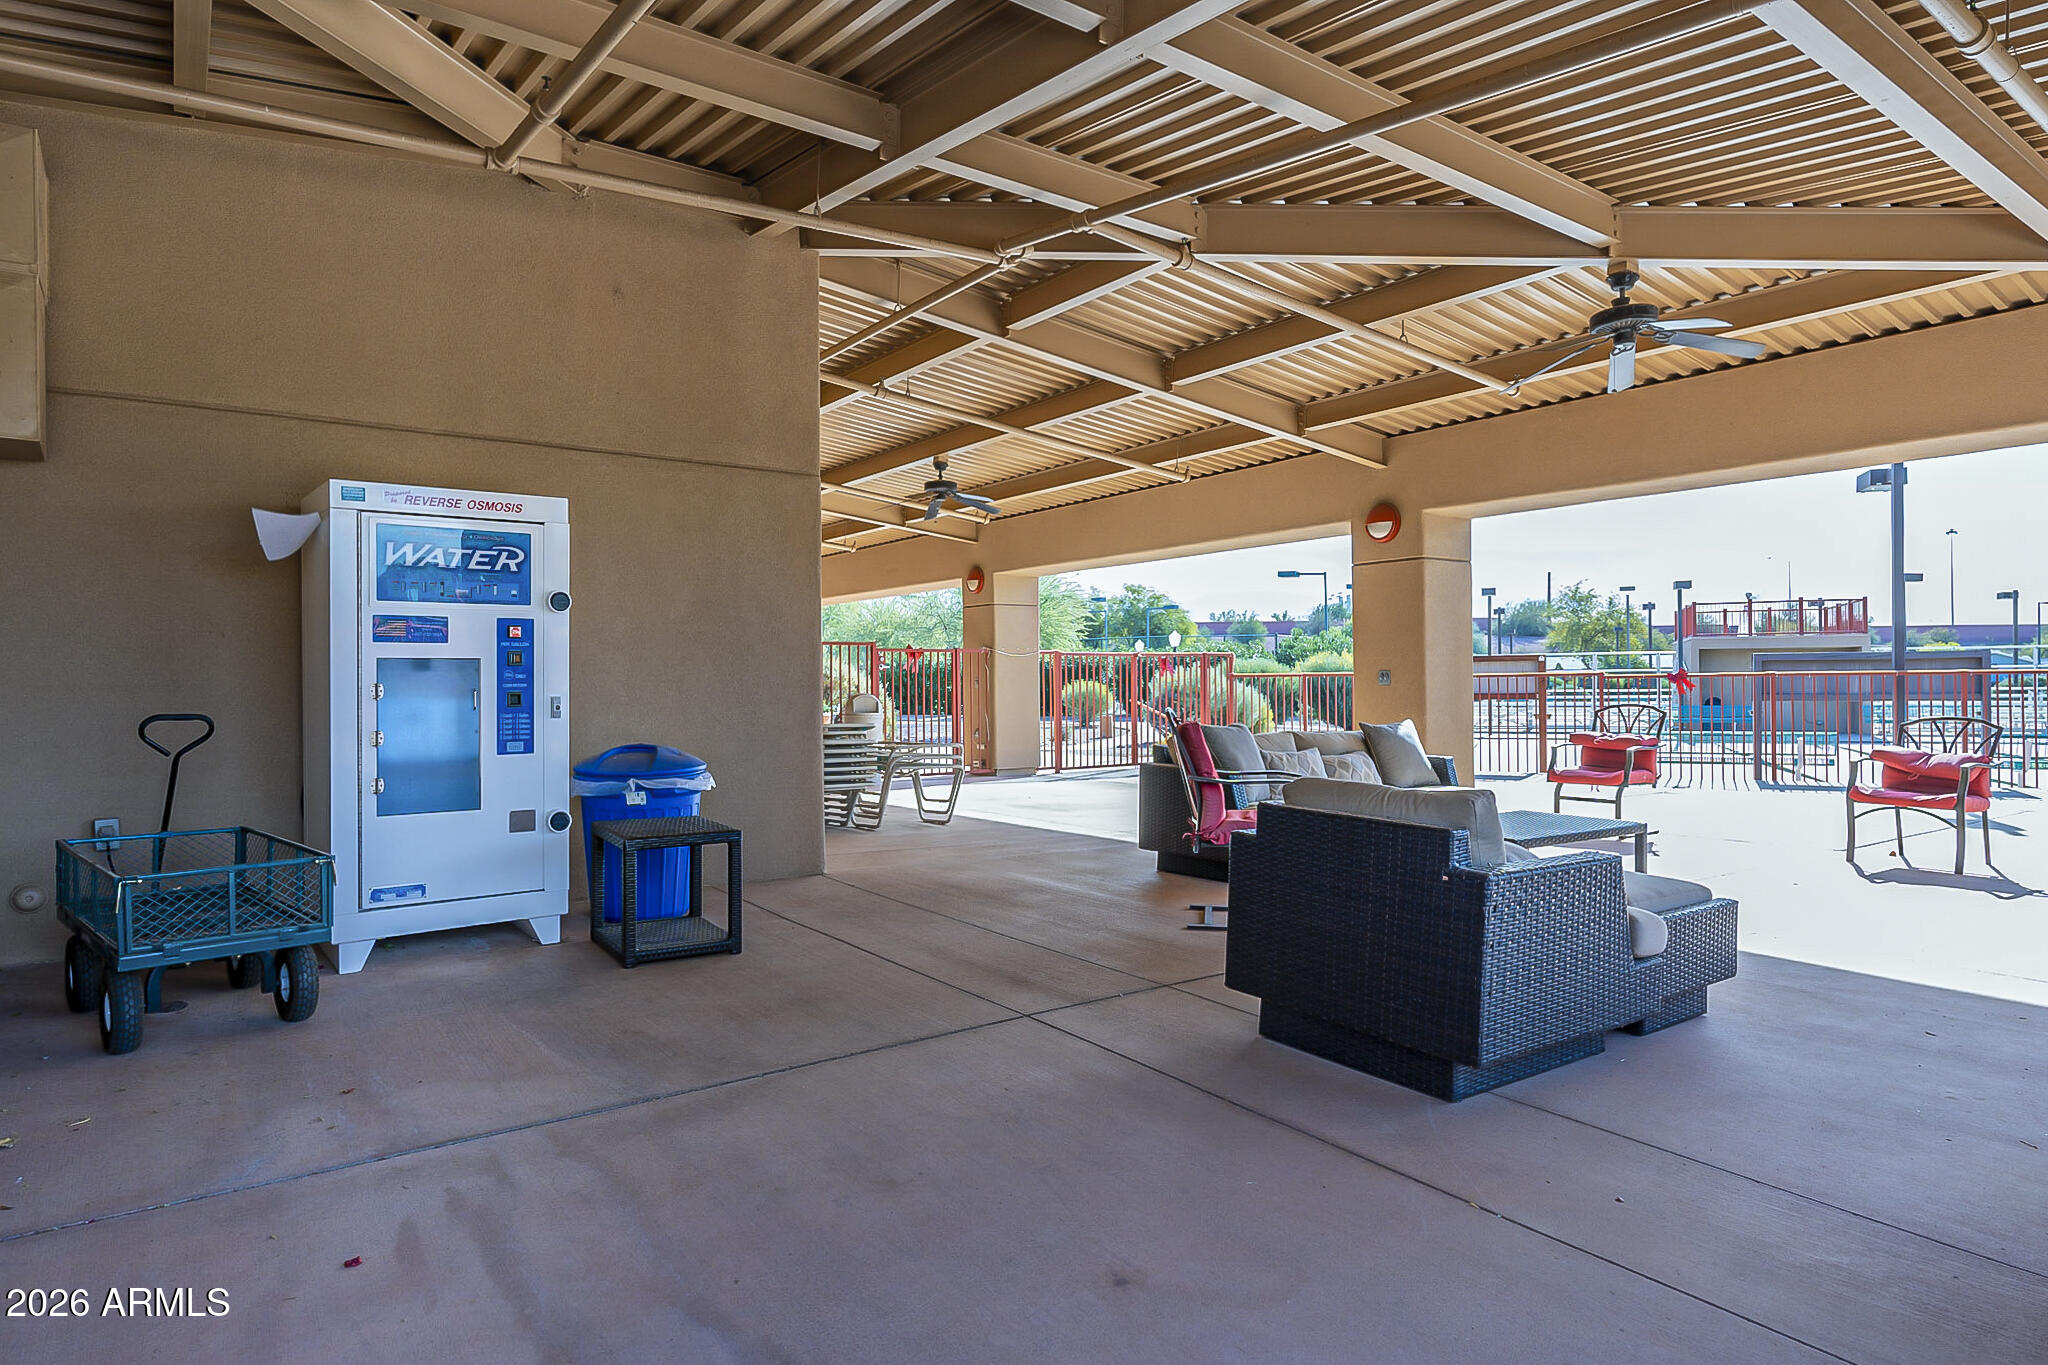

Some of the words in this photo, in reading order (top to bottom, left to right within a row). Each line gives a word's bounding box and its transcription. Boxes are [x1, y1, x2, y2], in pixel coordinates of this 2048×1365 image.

[404, 495, 463, 509] REVERSE
[467, 499, 523, 513] OSMOSIS
[385, 541, 525, 572] WATER
